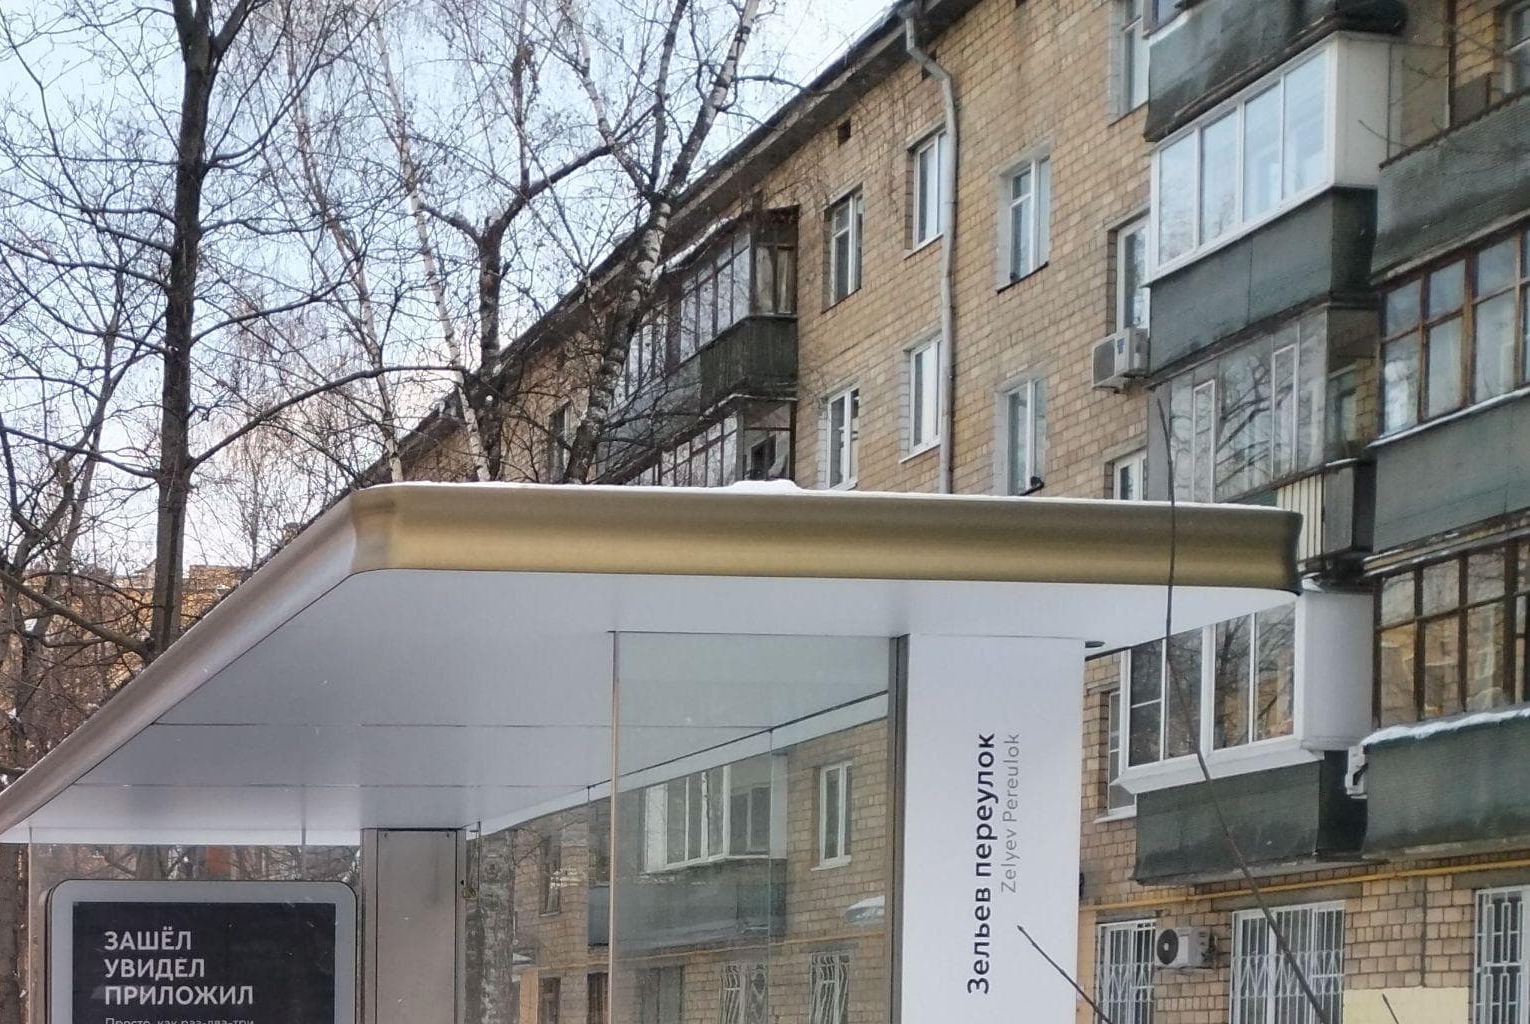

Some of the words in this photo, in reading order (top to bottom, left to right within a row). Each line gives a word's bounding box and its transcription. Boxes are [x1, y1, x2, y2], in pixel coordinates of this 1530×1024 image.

[976, 733, 998, 877] переулок
[1002, 734, 1019, 822] Pereulok
[1001, 828, 1020, 893] Zelyev
[104, 926, 192, 950] ЗАШЁЛ
[104, 958, 205, 981] УВИДЕЛ
[967, 887, 991, 994] Зельев
[105, 985, 254, 1006] ПРИЛОЖИЛ
